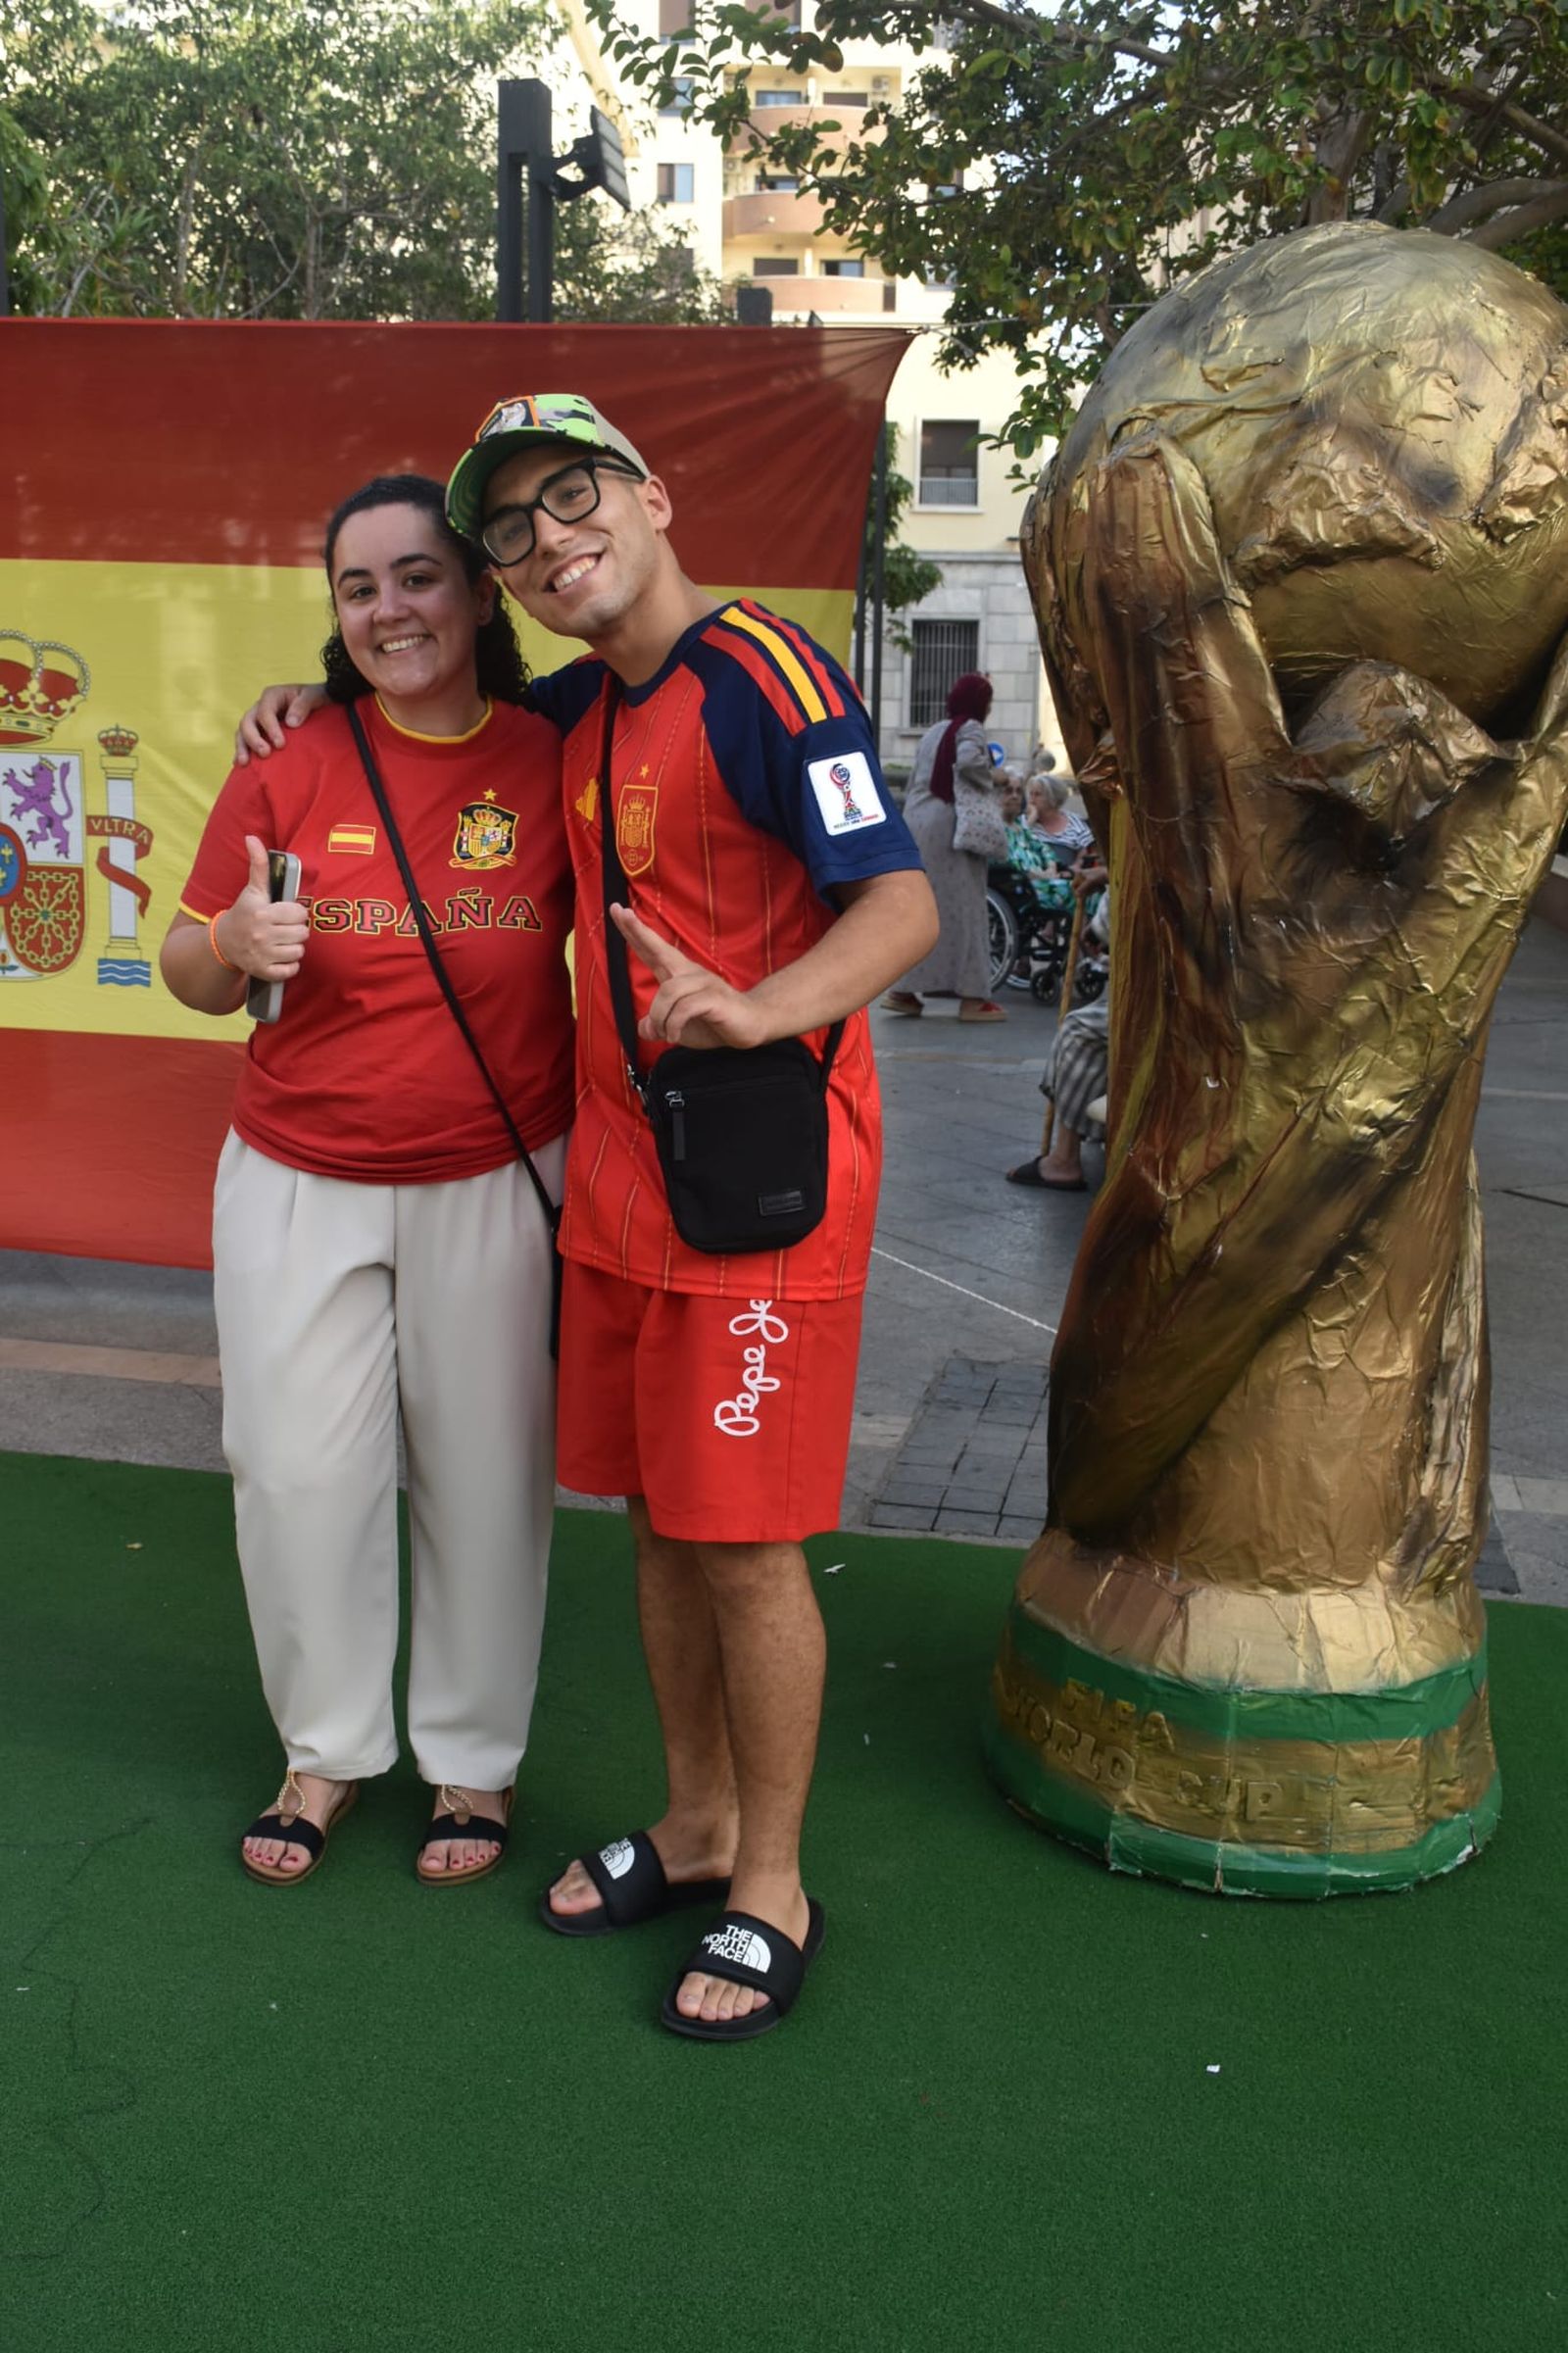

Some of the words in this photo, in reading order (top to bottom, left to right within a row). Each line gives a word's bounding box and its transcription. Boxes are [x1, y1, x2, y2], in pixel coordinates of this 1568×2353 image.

[90, 816, 150, 845] VLTRA
[713, 1343, 781, 1438] Pepe
[701, 1933, 750, 1953] NORTH
[725, 1924, 754, 1942] THE
[708, 1943, 745, 1963] FACE
